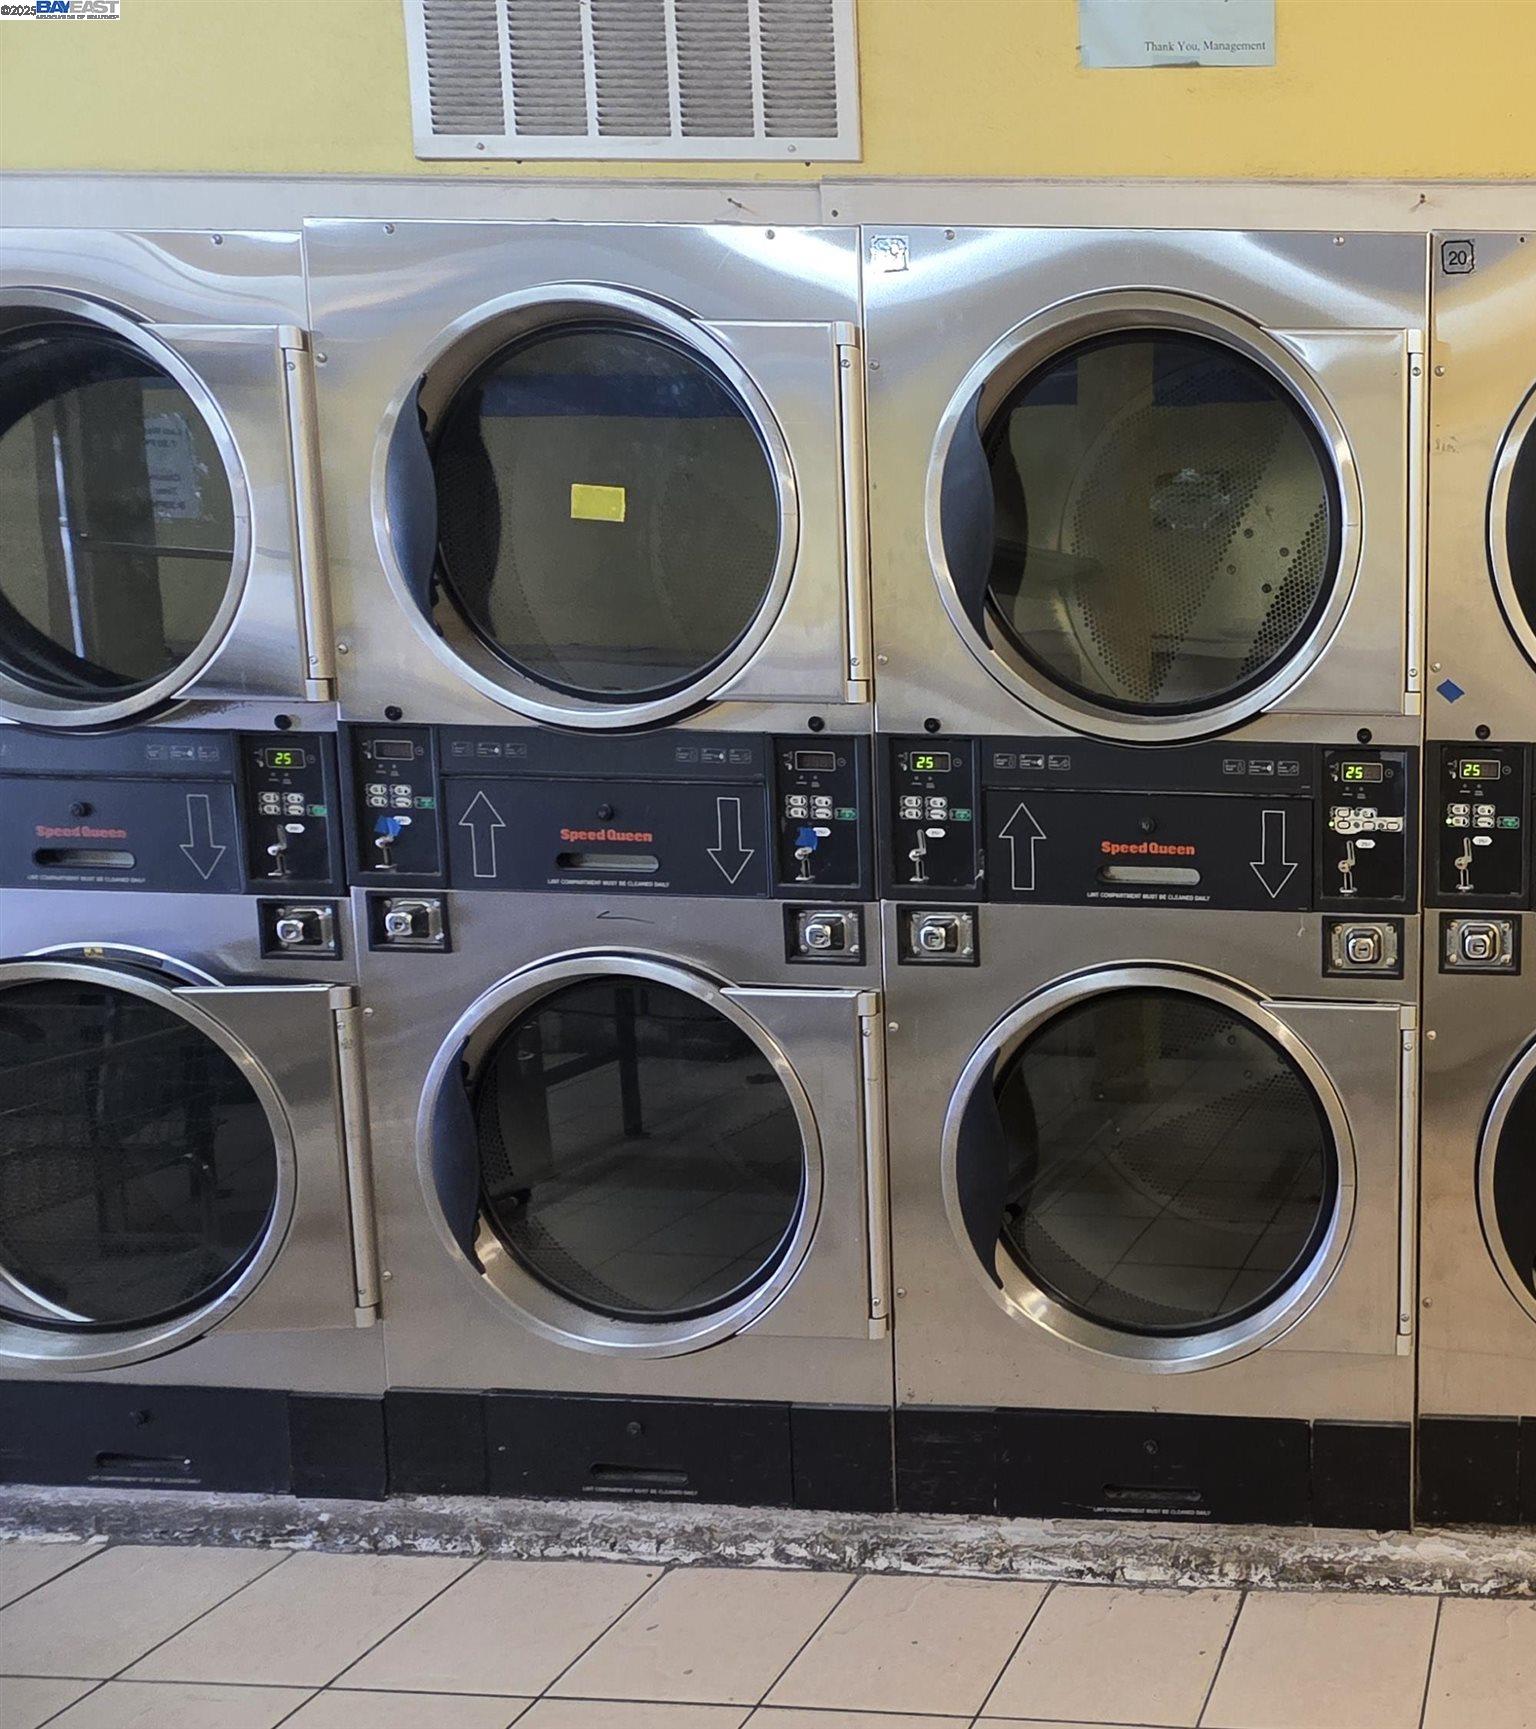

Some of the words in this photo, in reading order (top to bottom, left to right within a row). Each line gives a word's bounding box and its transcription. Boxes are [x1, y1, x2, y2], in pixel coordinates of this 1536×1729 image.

[1145, 41, 1174, 51] Thank
[1203, 41, 1266, 53] Management
[1448, 250, 1467, 266] 20
[274, 752, 292, 765] 25
[916, 756, 934, 769] 25
[1345, 766, 1363, 779] 25
[1463, 764, 1480, 776] 25
[560, 828, 605, 842] Speed
[607, 829, 653, 842] Queen
[1101, 841, 1147, 855] Speed
[1149, 842, 1195, 855] Queen
